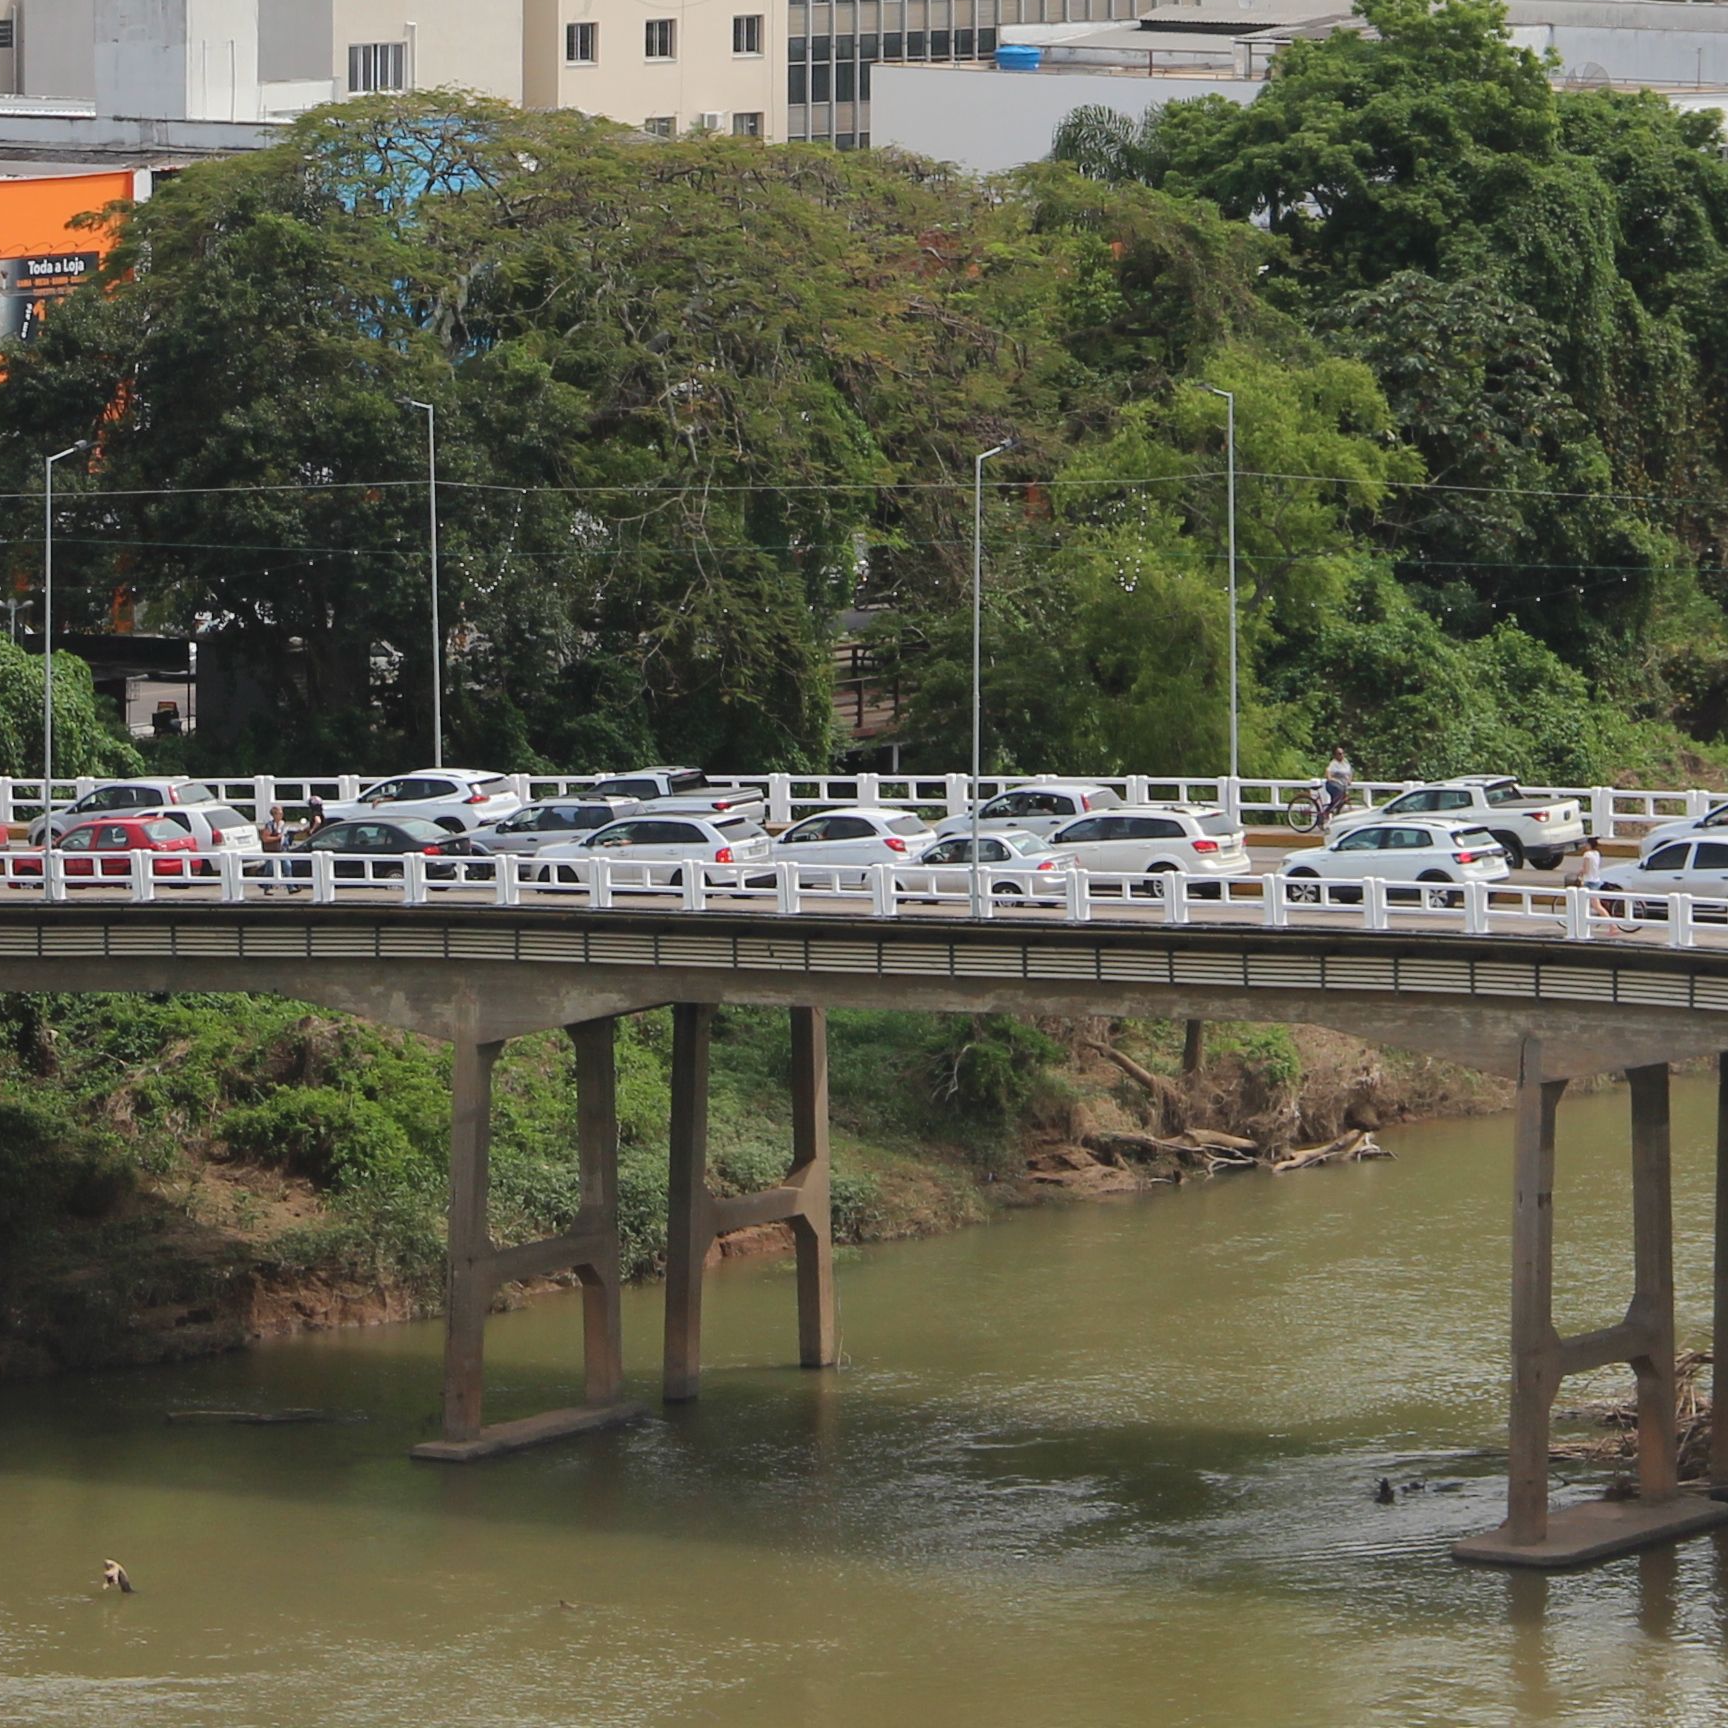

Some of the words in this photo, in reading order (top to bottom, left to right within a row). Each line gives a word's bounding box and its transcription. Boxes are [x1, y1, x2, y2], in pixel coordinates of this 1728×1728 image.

[27, 259, 53, 275] Toda
[54, 261, 62, 273] a
[63, 257, 85, 276] Loja
